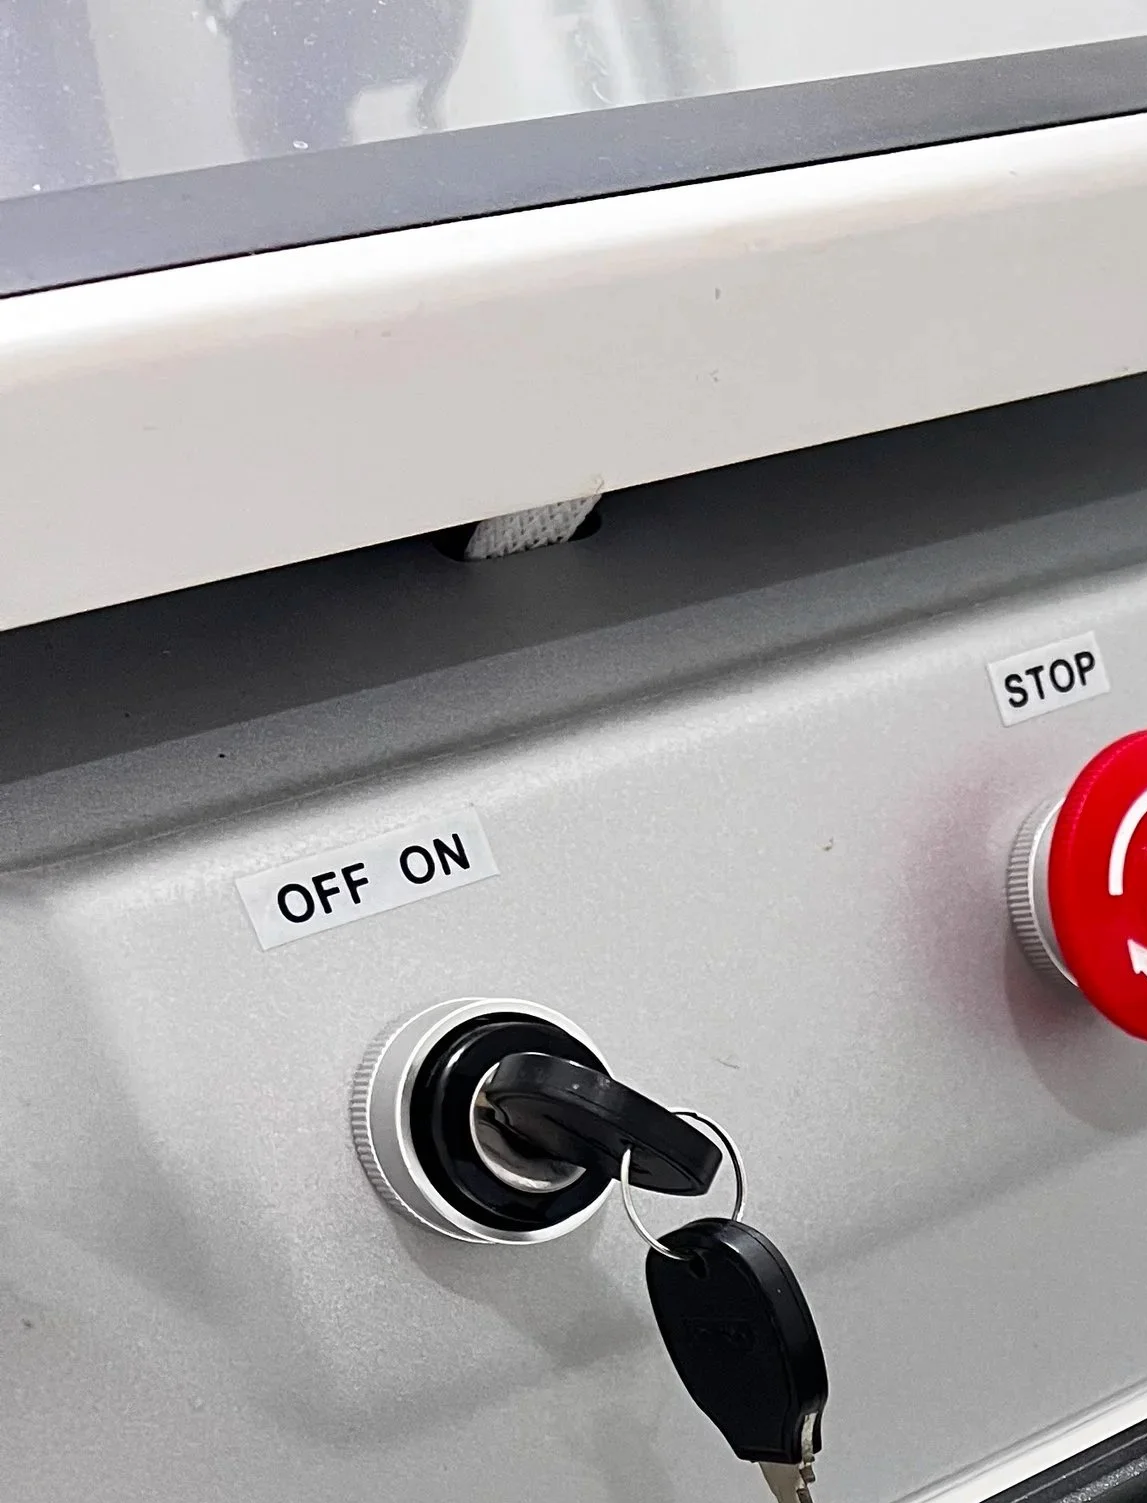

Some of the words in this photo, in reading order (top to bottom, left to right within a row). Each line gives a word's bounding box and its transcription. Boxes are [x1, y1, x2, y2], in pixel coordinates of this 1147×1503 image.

[1004, 651, 1095, 708] STOP
[277, 862, 369, 923] OFF
[399, 833, 471, 884] ON
